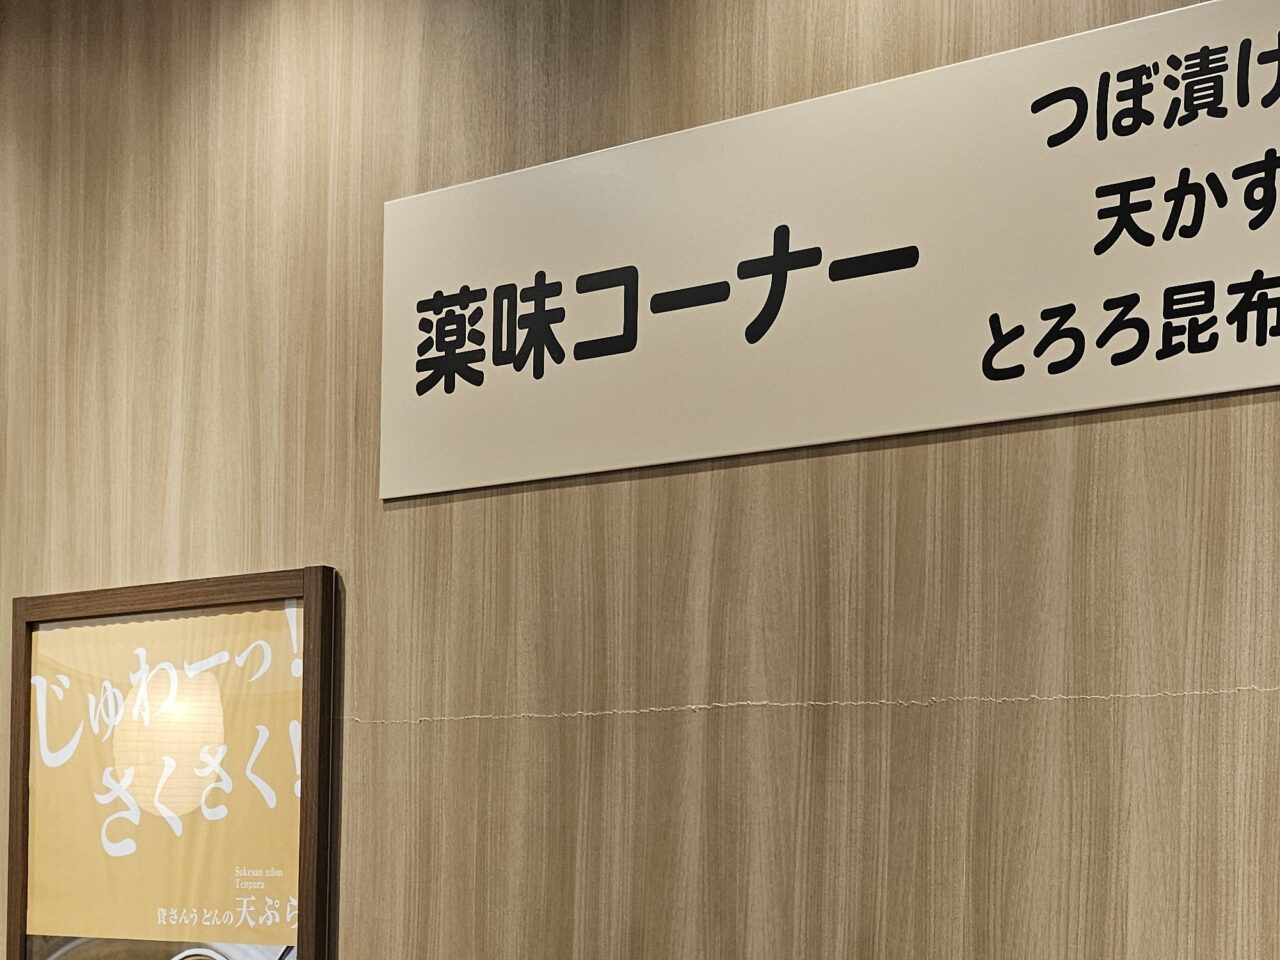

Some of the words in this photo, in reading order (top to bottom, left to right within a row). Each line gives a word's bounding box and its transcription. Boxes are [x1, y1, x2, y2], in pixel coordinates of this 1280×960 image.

[415, 224, 919, 396] 薬味コーナー
